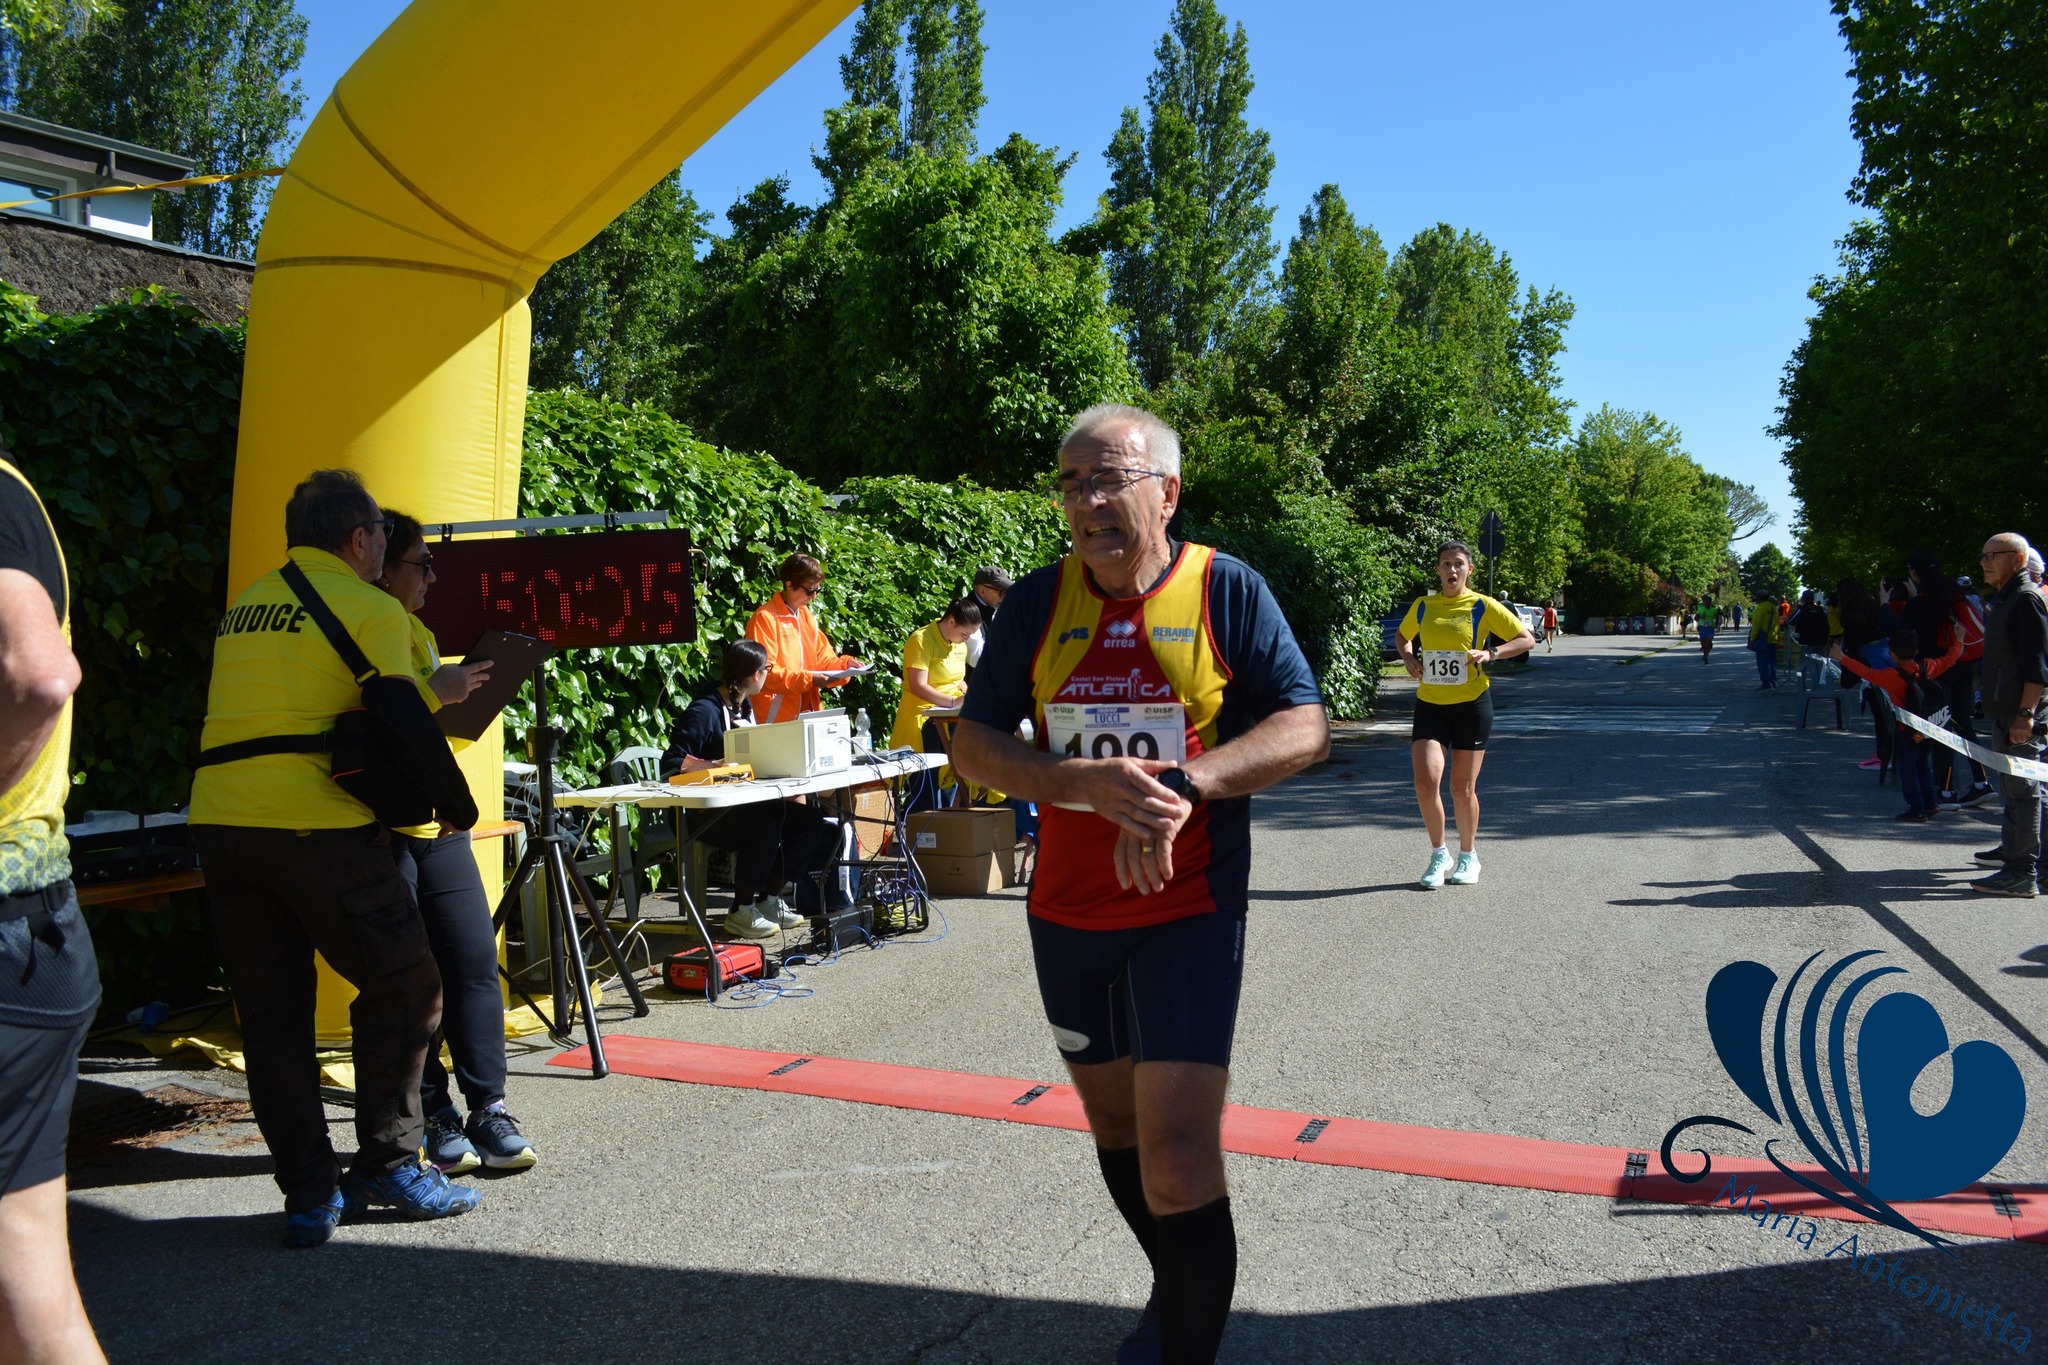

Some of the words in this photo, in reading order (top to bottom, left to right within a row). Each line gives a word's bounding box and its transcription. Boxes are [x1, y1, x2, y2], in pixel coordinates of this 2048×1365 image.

[218, 603, 307, 637] GIUDICE
[1153, 627, 1194, 638] BERARDI
[1429, 659, 1460, 677] 136
[1928, 705, 1950, 726] NIKE
